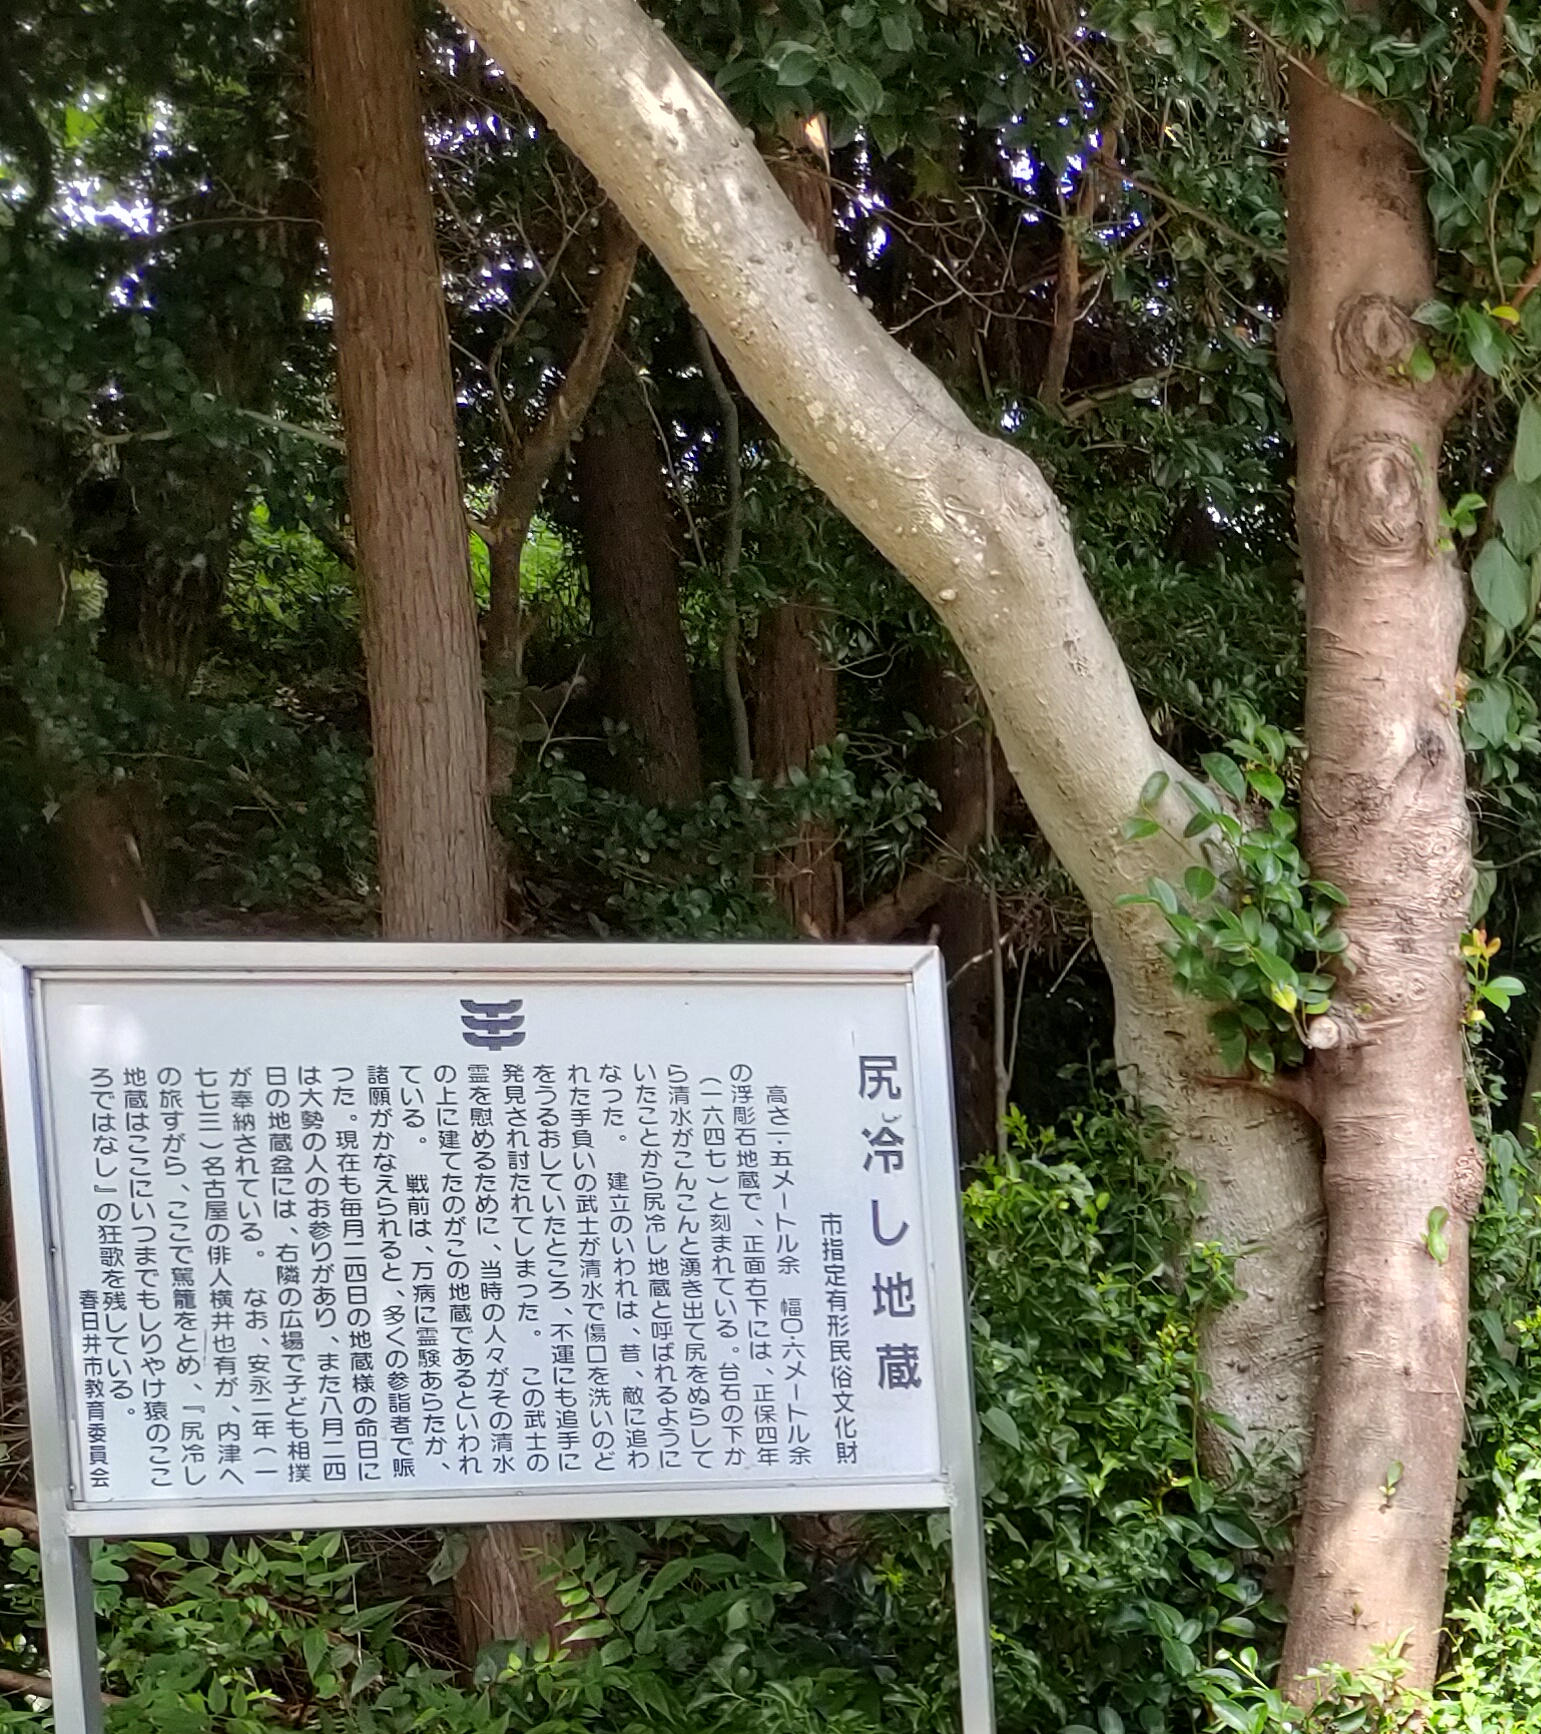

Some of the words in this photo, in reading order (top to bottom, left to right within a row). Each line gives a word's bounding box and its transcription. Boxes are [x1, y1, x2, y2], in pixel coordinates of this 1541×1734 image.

[79, 1289, 109, 1488] 春日井市教育委員会
[123, 1067, 173, 1487] 地蔵はここにいつまでもしりやけ猿のここ
[266, 1067, 312, 1483] 日の地蔵盆には、右隣の広場で子ども相撲
[298, 1066, 346, 1481] は大勢の人のお参りがあり、また八月二四
[434, 1065, 483, 1475] の上に建てたのがこの地蔵であるといわれ
[467, 1064, 515, 1474] 霊を慰めるために、当時の人々がその清水
[532, 1064, 581, 1472] をうるおしていたところ、不運にも追手に
[567, 1064, 615, 1471] れた手負いの武士が清水で傷口を洗いのど
[633, 1063, 681, 1469] いたことから尻冷し地蔵と呼ばれるように
[667, 1064, 715, 1469] ら清水がこんこんと湧き出て尻をぬらして
[730, 1064, 779, 1466] の浮彫石地蔵で、正面右下には、正保四年
[820, 1213, 858, 1465] 市指定有形民俗文化財
[858, 1055, 922, 1390] 尻冷し地蔵
